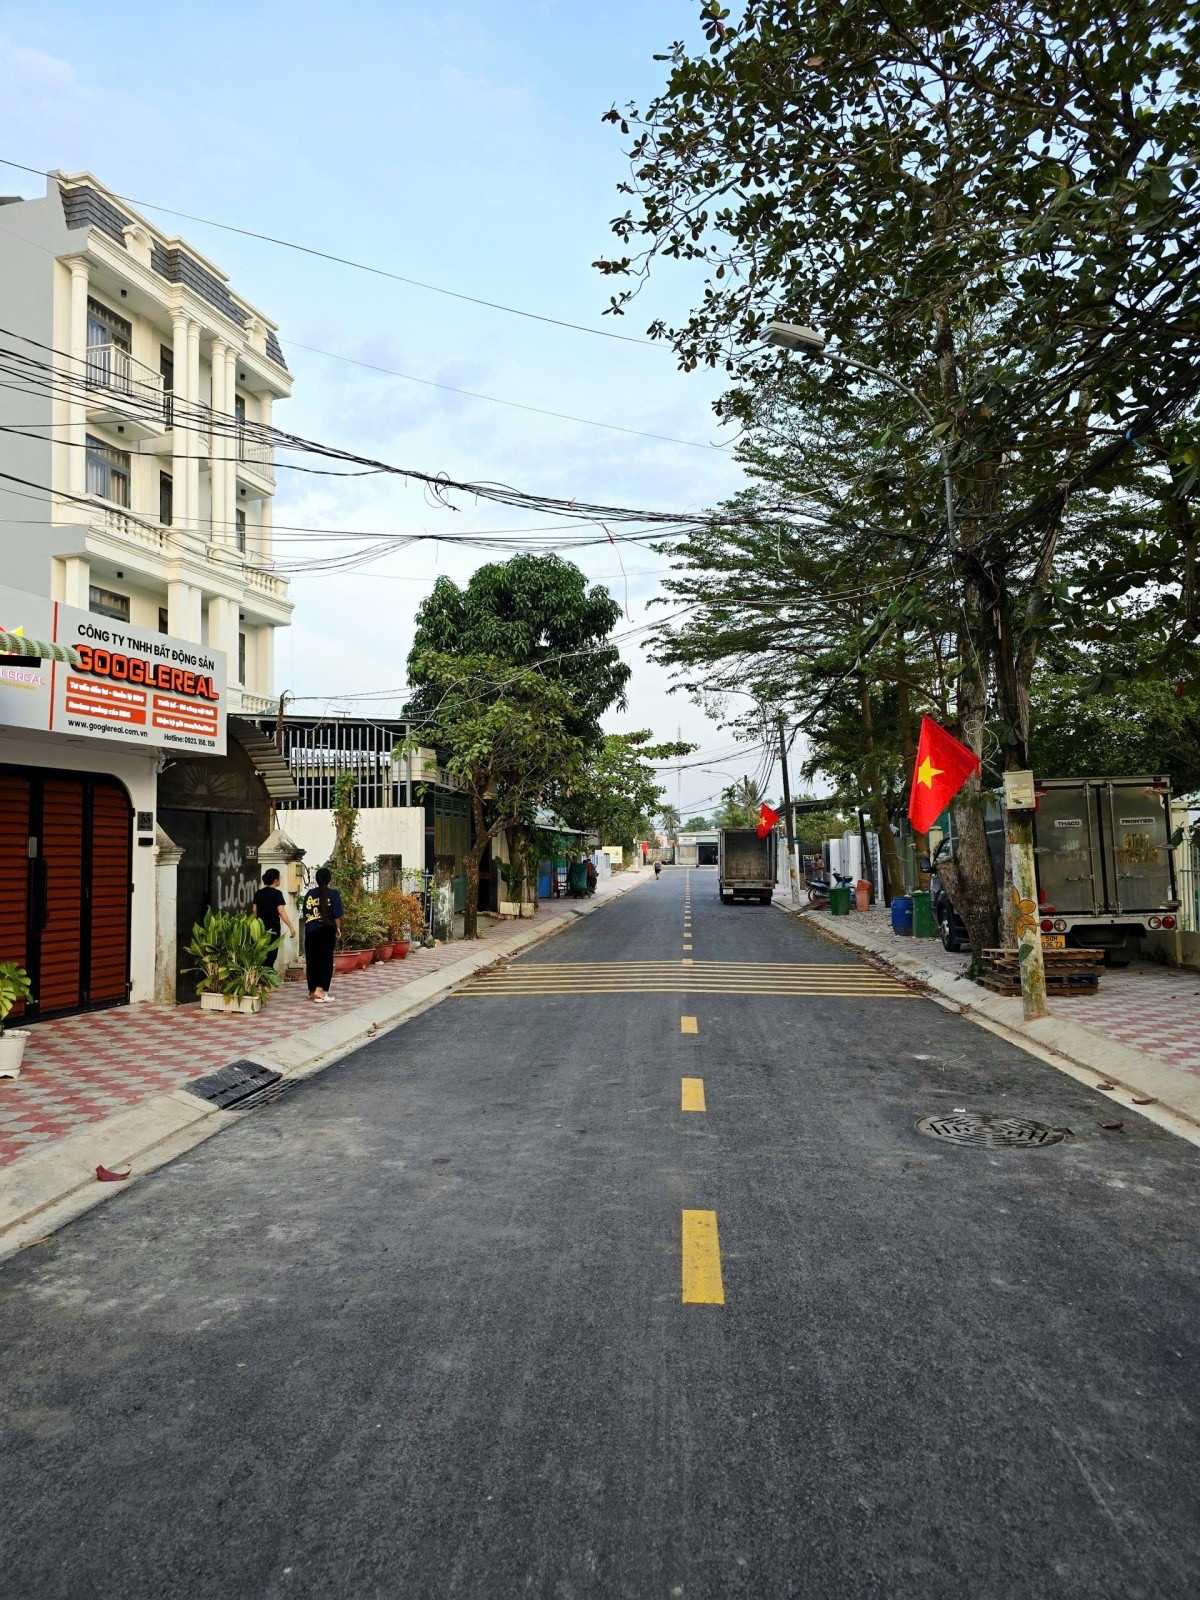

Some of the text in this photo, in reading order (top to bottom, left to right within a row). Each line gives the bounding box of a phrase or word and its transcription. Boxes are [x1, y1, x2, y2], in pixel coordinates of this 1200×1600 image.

[77, 623, 215, 670] CÔNG TY TNHH BẤT ĐỘNG SẢN
[72, 644, 219, 700] GOOGLEREAL
[163, 733, 184, 743] Hotline:
